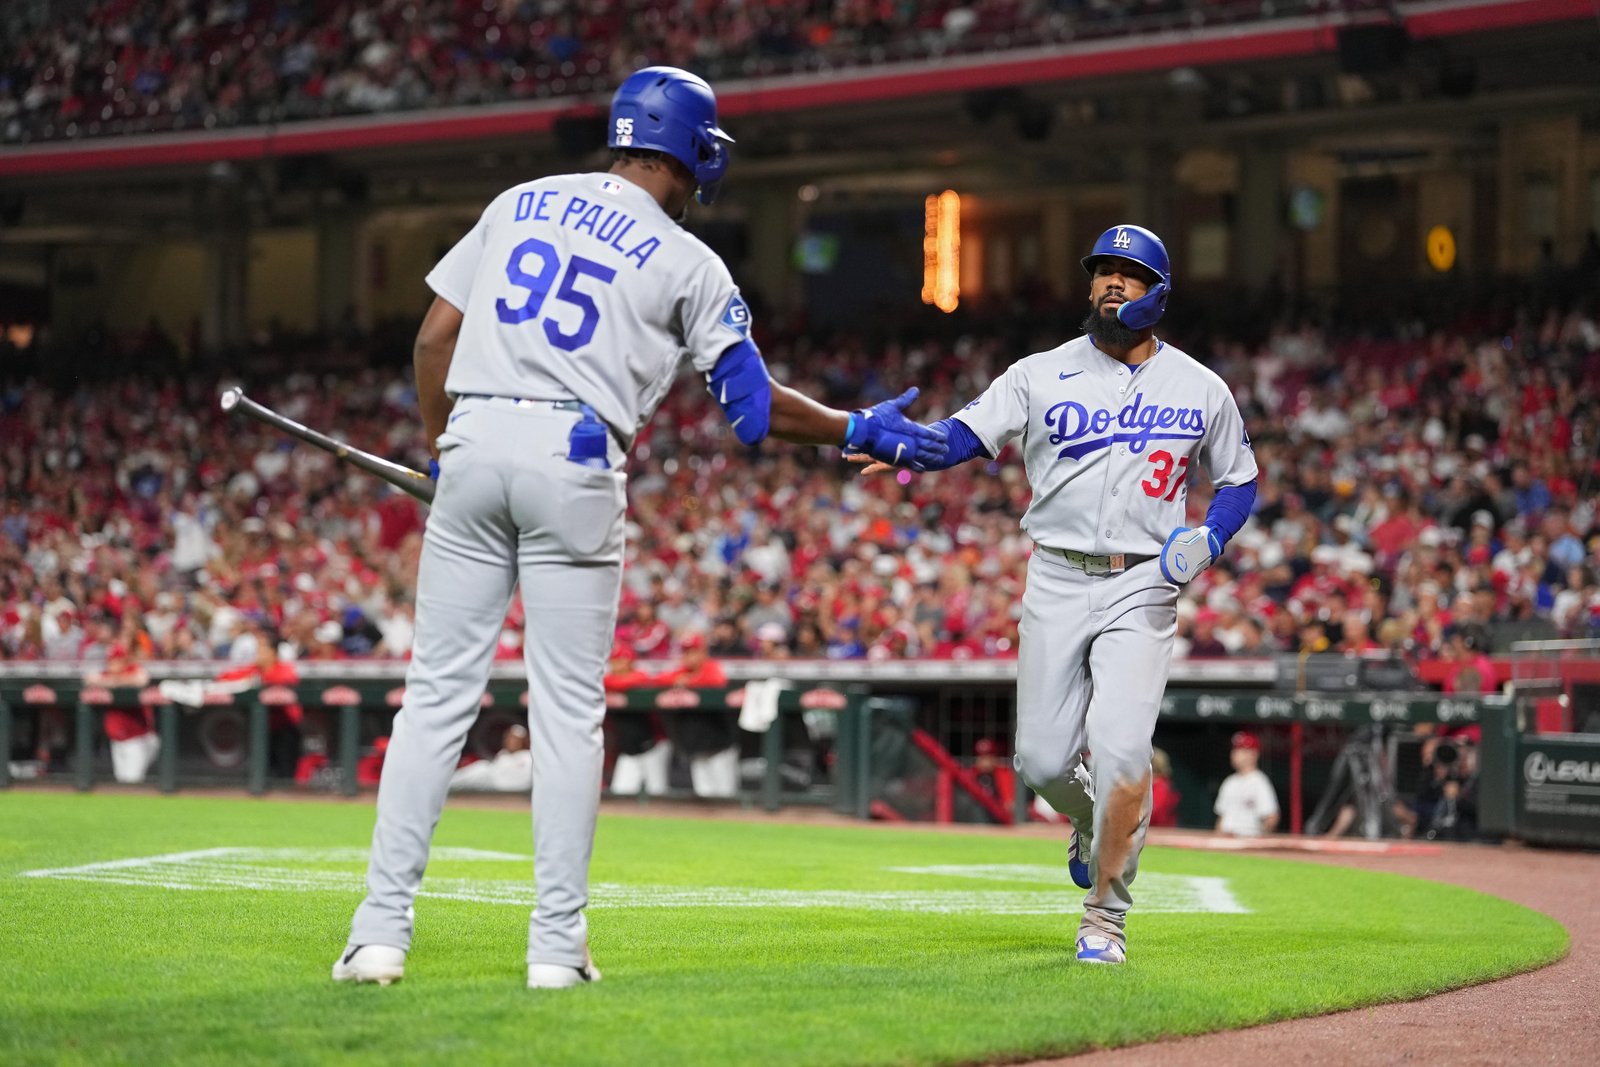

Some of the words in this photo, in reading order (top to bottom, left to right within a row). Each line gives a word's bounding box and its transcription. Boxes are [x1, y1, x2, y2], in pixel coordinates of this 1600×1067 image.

[616, 118, 634, 135] 95
[514, 190, 559, 222] DE
[560, 196, 661, 270] PAULA
[1112, 226, 1131, 249] LA
[495, 237, 618, 352] 95
[1044, 392, 1206, 455] Dodgers
[1141, 449, 1189, 503] 37
